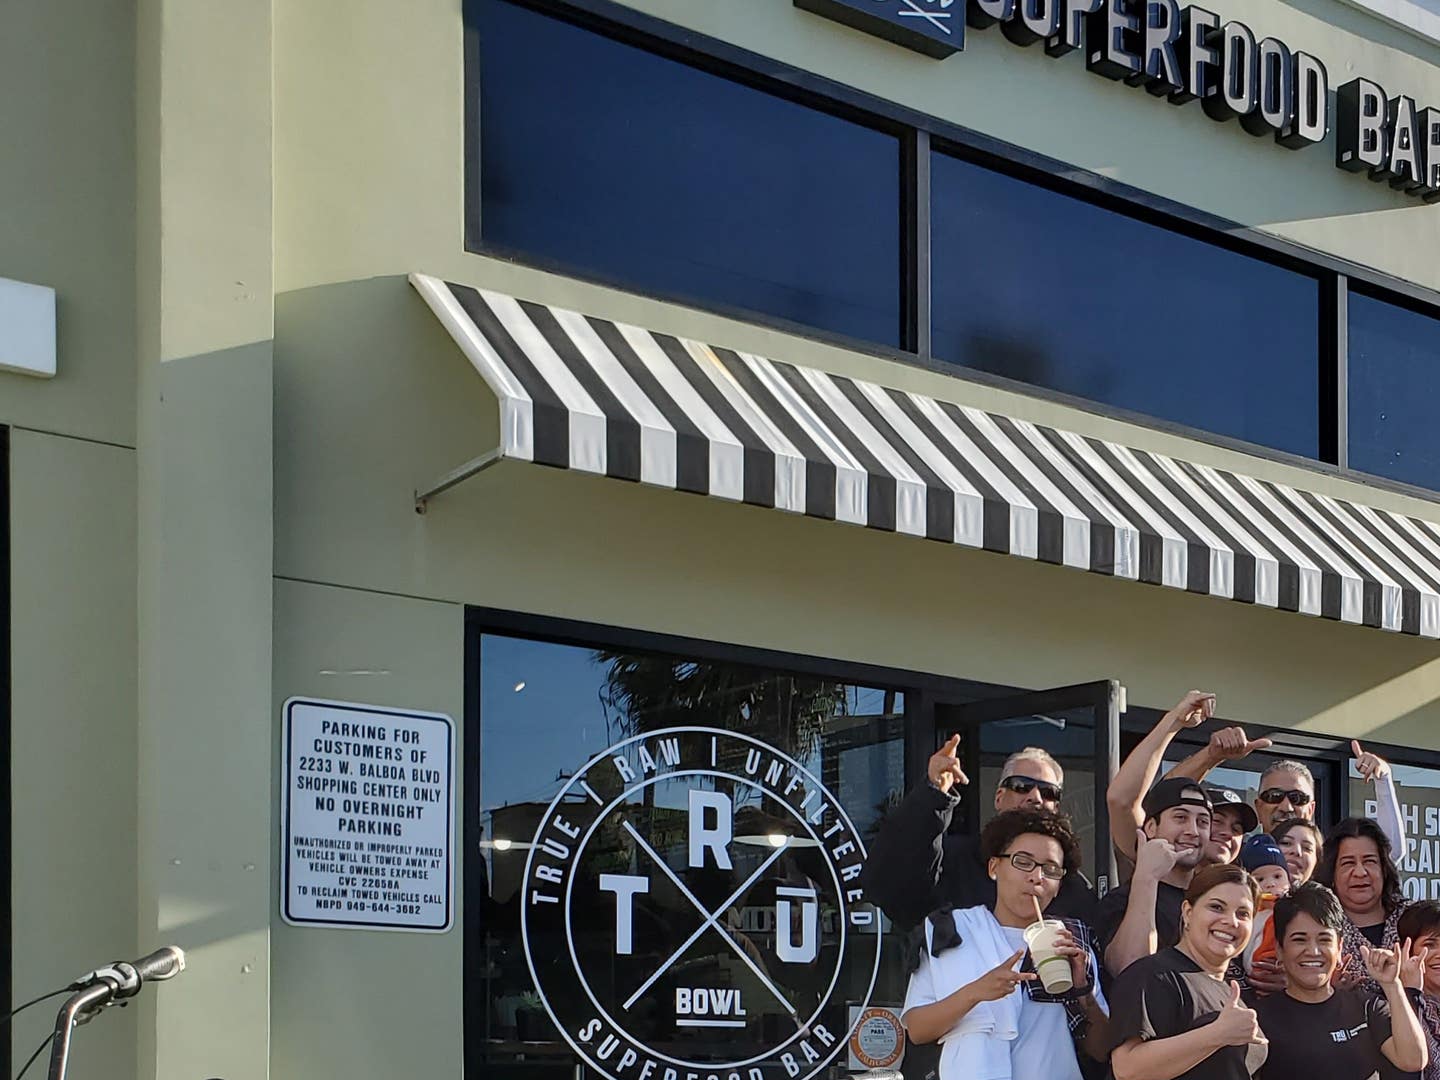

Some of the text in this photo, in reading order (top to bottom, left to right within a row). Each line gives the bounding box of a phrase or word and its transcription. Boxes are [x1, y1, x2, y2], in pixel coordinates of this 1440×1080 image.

[322, 721, 420, 745] PARKING FOR
[313, 739, 427, 764] CUSTOMERS OF
[613, 737, 681, 785] RAW
[300, 756, 440, 784] 2233 W. BALBOA BLVD
[297, 776, 441, 803] SHOPPING CENTER ONLY
[315, 797, 424, 820] NO OVERNIGHT
[338, 818, 402, 836] PARKING
[688, 789, 733, 870] R
[745, 747, 873, 927] UNFILTERED
[294, 836, 443, 858] UNAUTHORIZED OR IMPROPERLY PARKED
[296, 850, 440, 868] VEHICLES WILL BE TOWED AWAY AT
[532, 812, 583, 906] TRUE
[1400, 838, 1440, 874] CAI
[309, 862, 429, 880] VEHICLE OWNERS EXPENSE
[339, 877, 357, 887] CVC
[297, 886, 442, 904] TO RECLAIM TOWED VEHICLES CALL
[316, 899, 342, 910] NBPD
[600, 874, 649, 955] T
[675, 987, 747, 1017] BOWL
[781, 1024, 837, 1079] BAR
